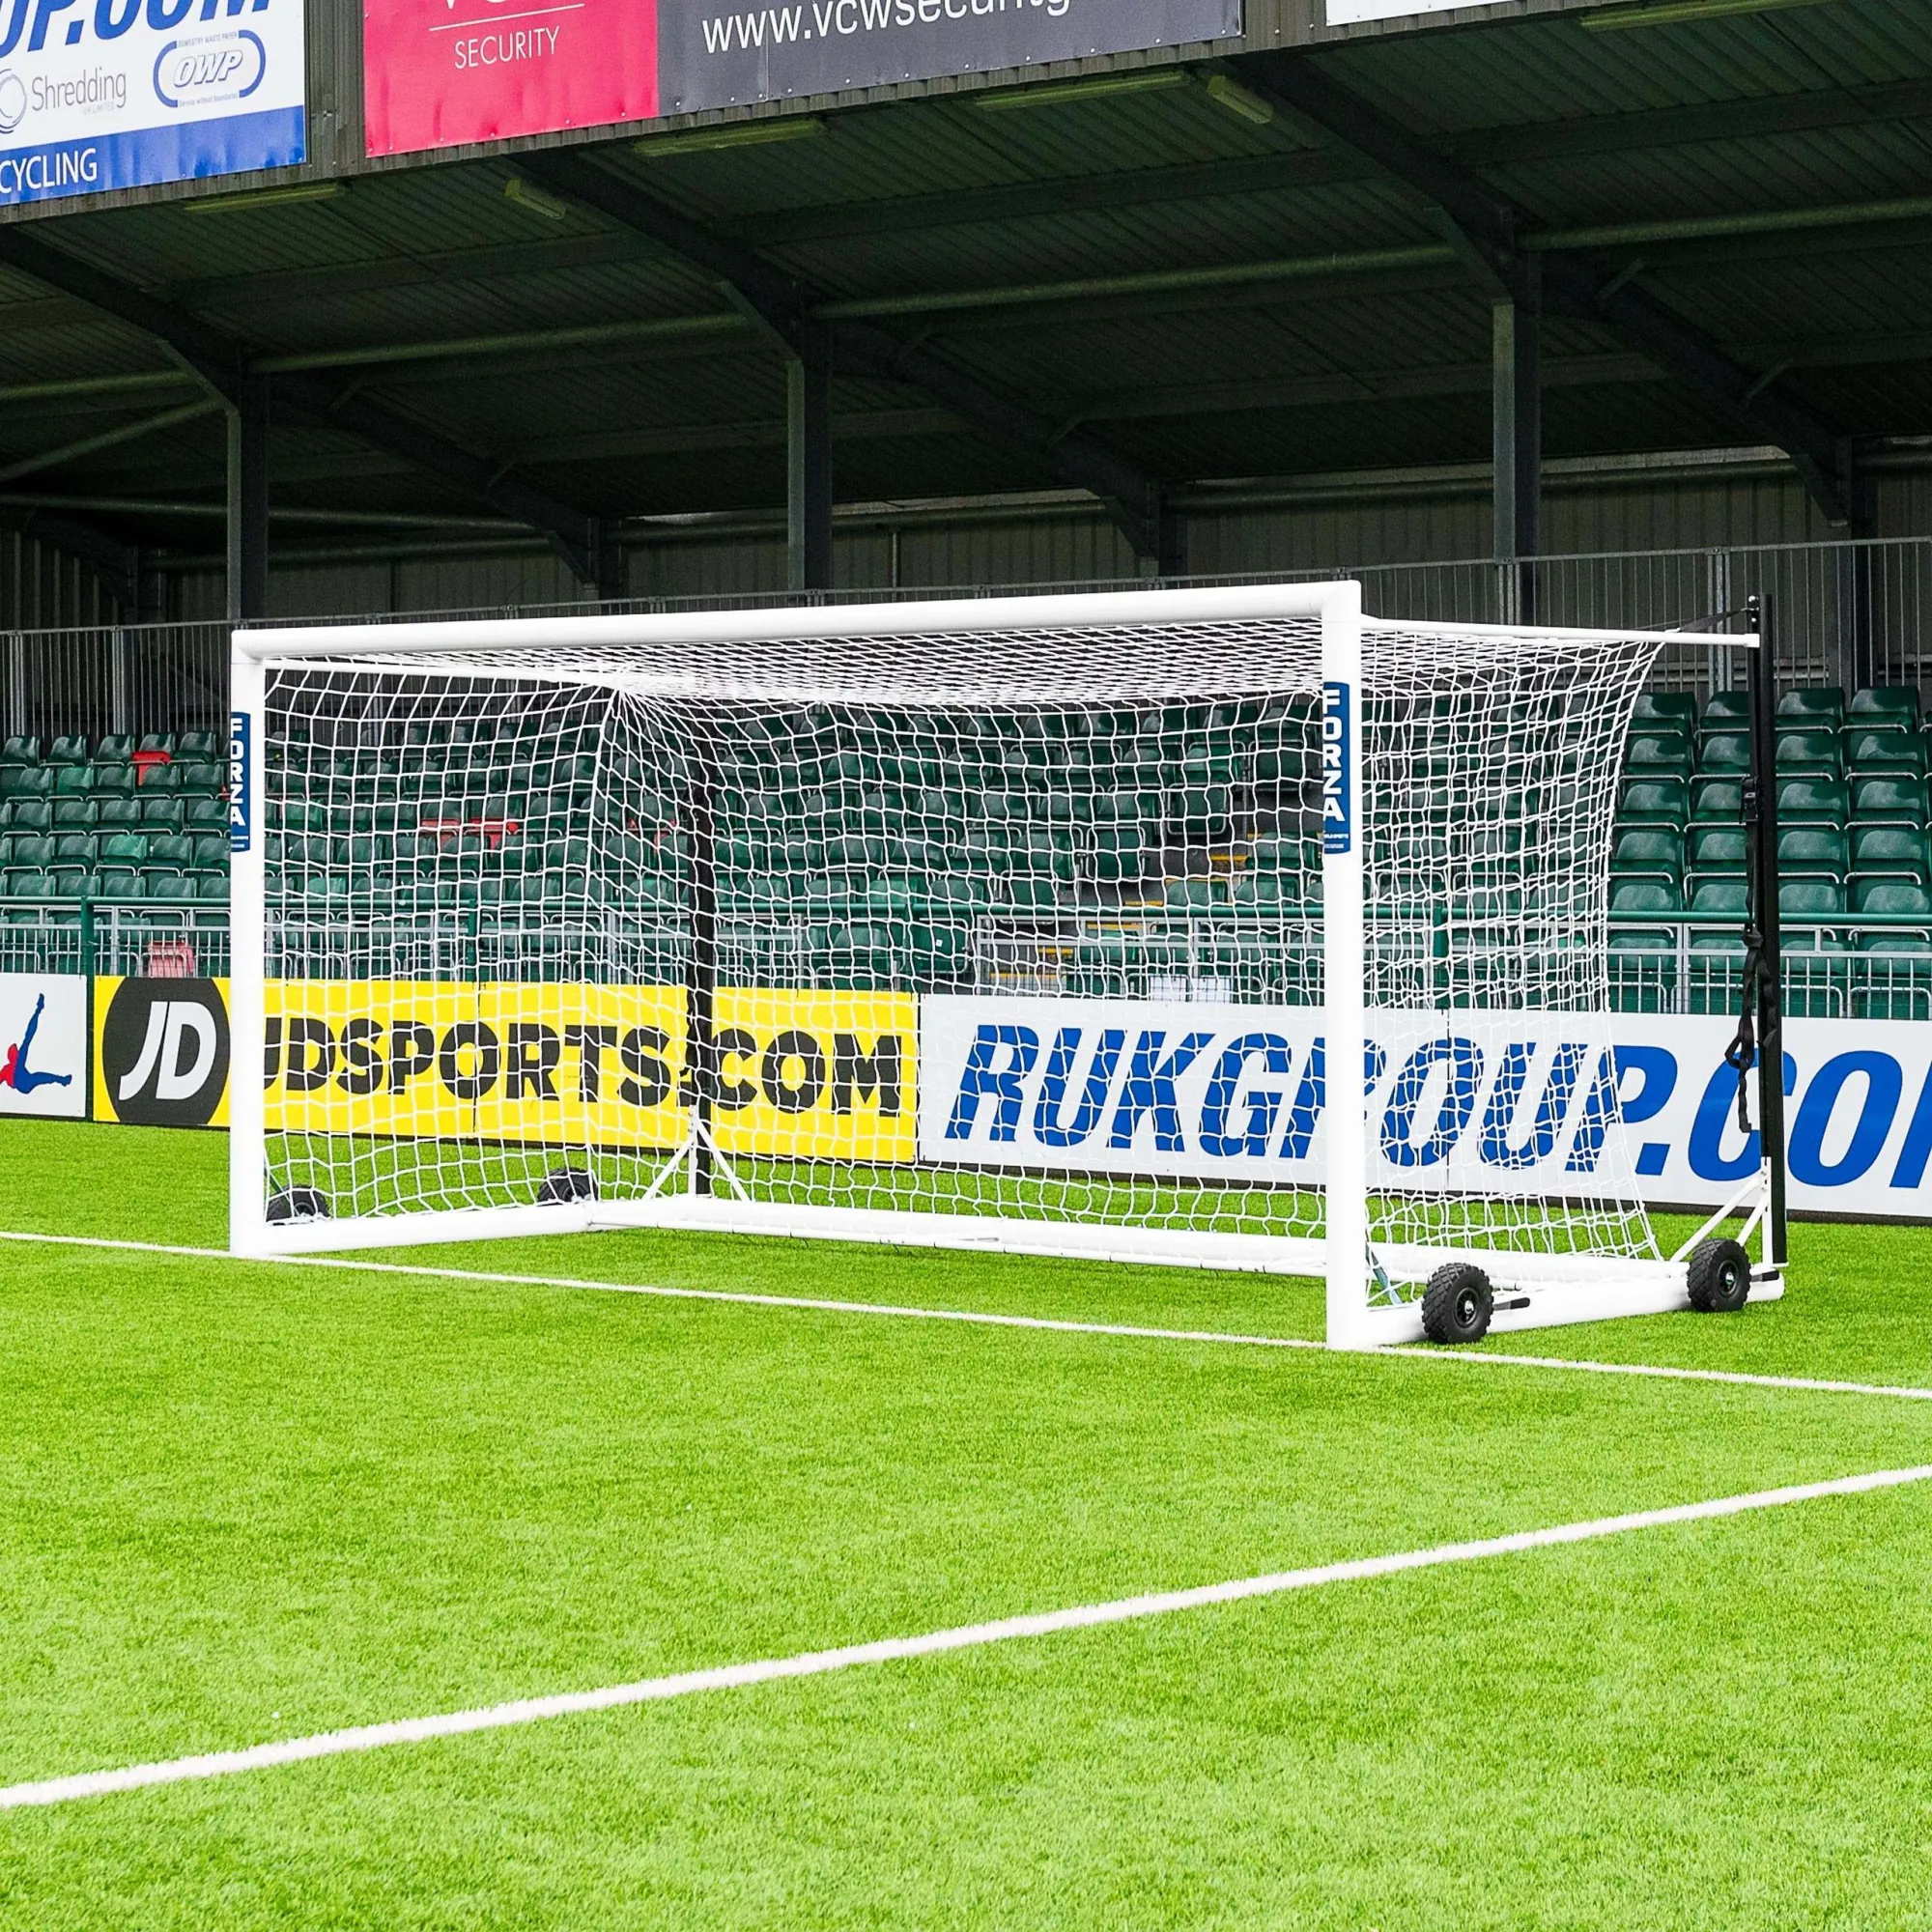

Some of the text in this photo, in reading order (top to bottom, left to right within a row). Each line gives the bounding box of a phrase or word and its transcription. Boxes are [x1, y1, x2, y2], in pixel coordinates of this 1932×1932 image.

[454, 26, 560, 70] SECURITY
[702, 0, 1070, 54] www.vcwsec
[32, 67, 127, 111] Shredding
[173, 49, 243, 88] OWP
[231, 718, 246, 827] FORZA
[1323, 689, 1346, 822] FORZA
[118, 1001, 217, 1101] JD
